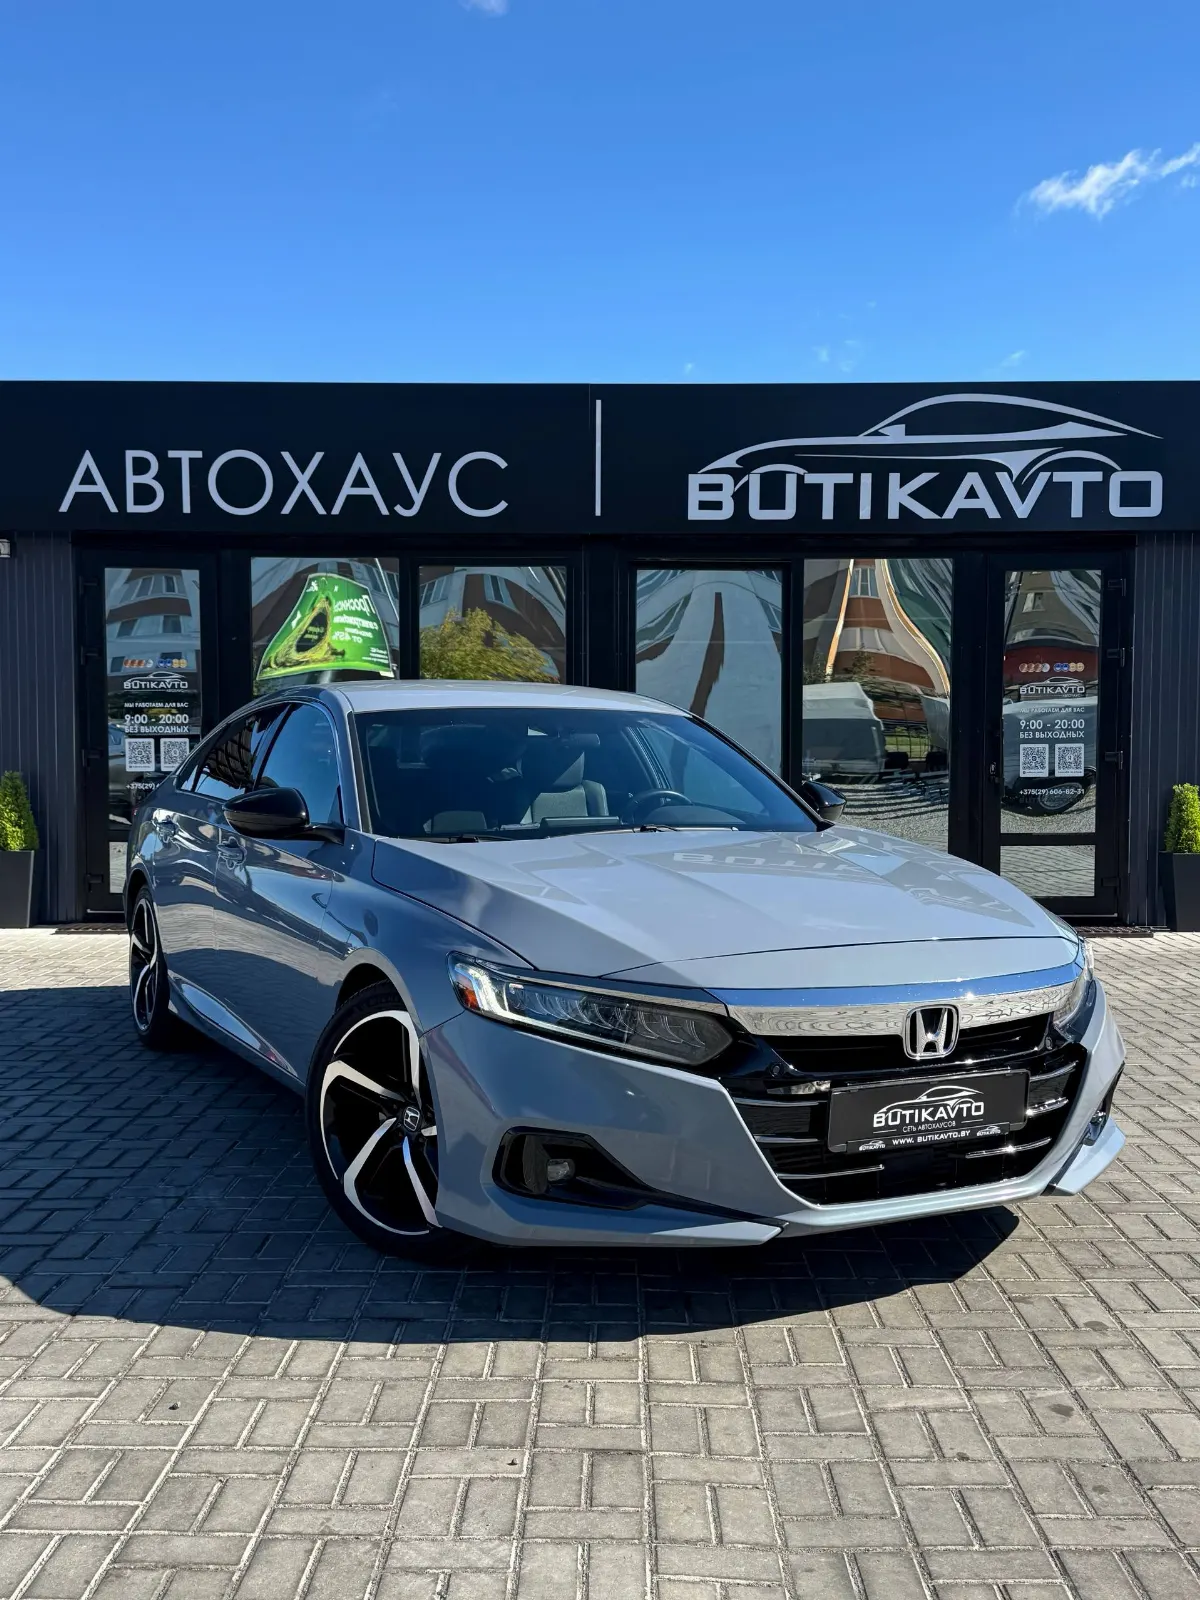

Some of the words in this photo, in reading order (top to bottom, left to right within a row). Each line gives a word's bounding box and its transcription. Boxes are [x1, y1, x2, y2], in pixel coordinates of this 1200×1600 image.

[58, 449, 509, 518] АВТОХАУС
[687, 470, 1163, 521] BUTIKAVTO
[123, 681, 189, 689] BUTIKAVTO
[1020, 686, 1085, 695] BUTIKAVTO
[124, 714, 148, 724] 9:00
[159, 714, 189, 724] 20:00
[1020, 720, 1043, 730] 9:00
[1054, 719, 1085, 729] 20:00
[140, 725, 189, 733] ВЫХОДНЫХ
[1020, 731, 1033, 739] БЕЗ
[1035, 731, 1085, 739] ВЫХОДНЫХ
[873, 1102, 984, 1128] BUTIKAVTO
[902, 1125, 917, 1133] СЕТЬ
[917, 1120, 956, 1131] АВТОХАУСОВ
[892, 1137, 914, 1146] WWW.
[917, 1130, 970, 1143] BUTIKAVTO.BY
